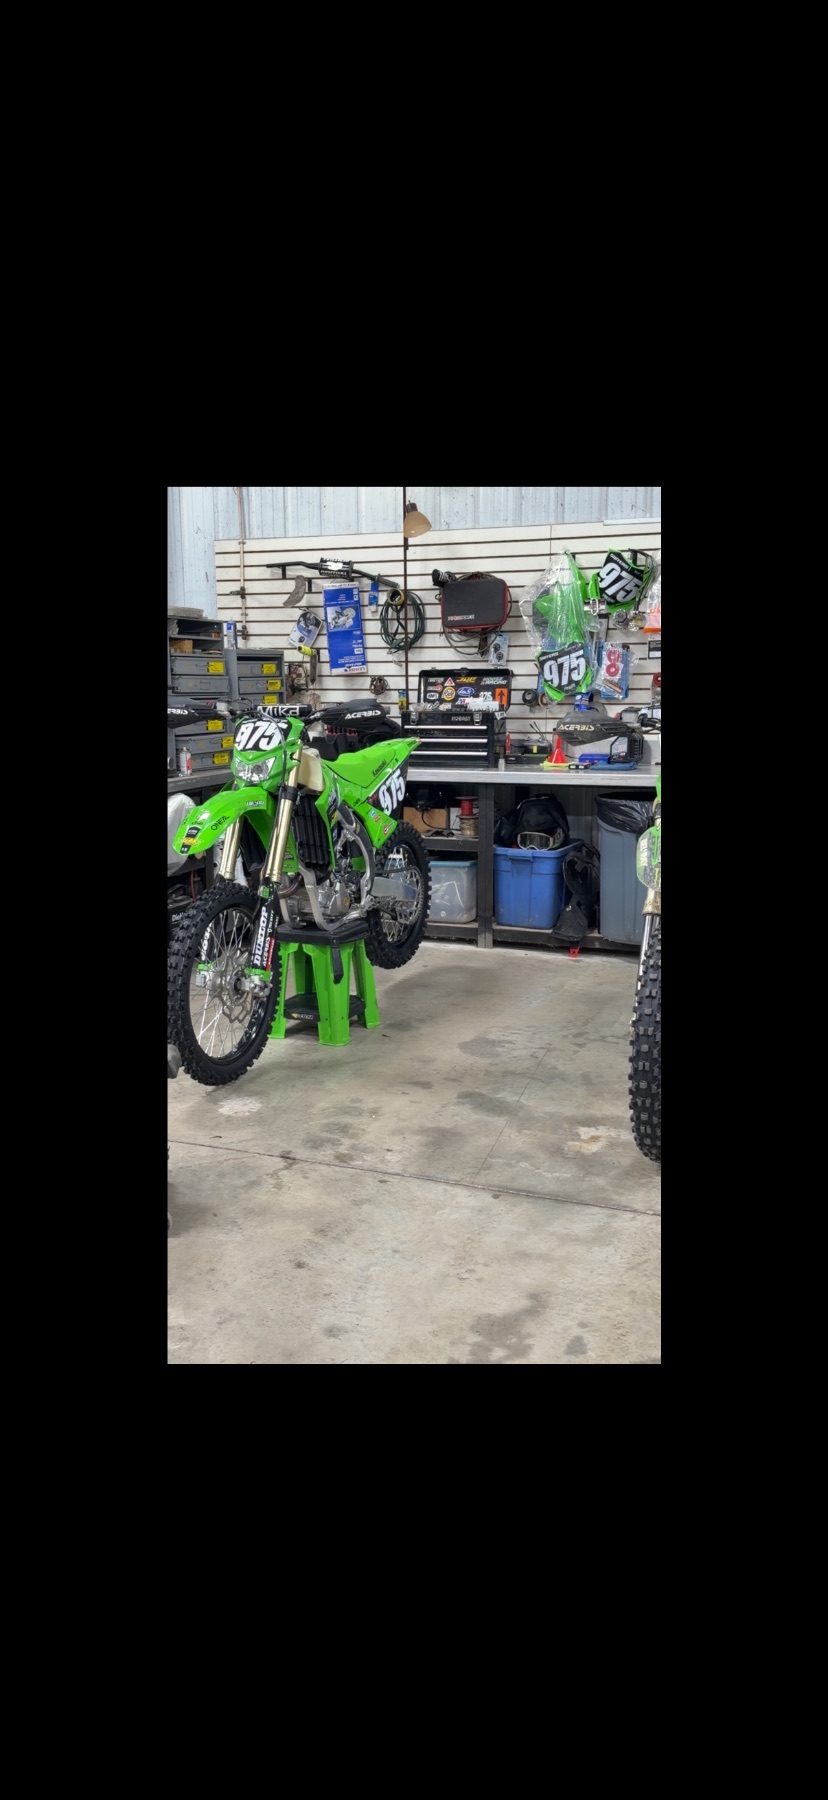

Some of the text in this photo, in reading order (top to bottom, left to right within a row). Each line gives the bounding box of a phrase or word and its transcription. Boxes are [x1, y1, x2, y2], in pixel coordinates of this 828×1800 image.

[598, 562, 643, 603] 975
[543, 649, 586, 688] 975
[345, 709, 381, 720] ACERBIS
[235, 720, 288, 751] 975
[379, 768, 405, 816] 975
[253, 906, 270, 967] DUNLOP
[263, 936, 271, 967] ACERBIS
